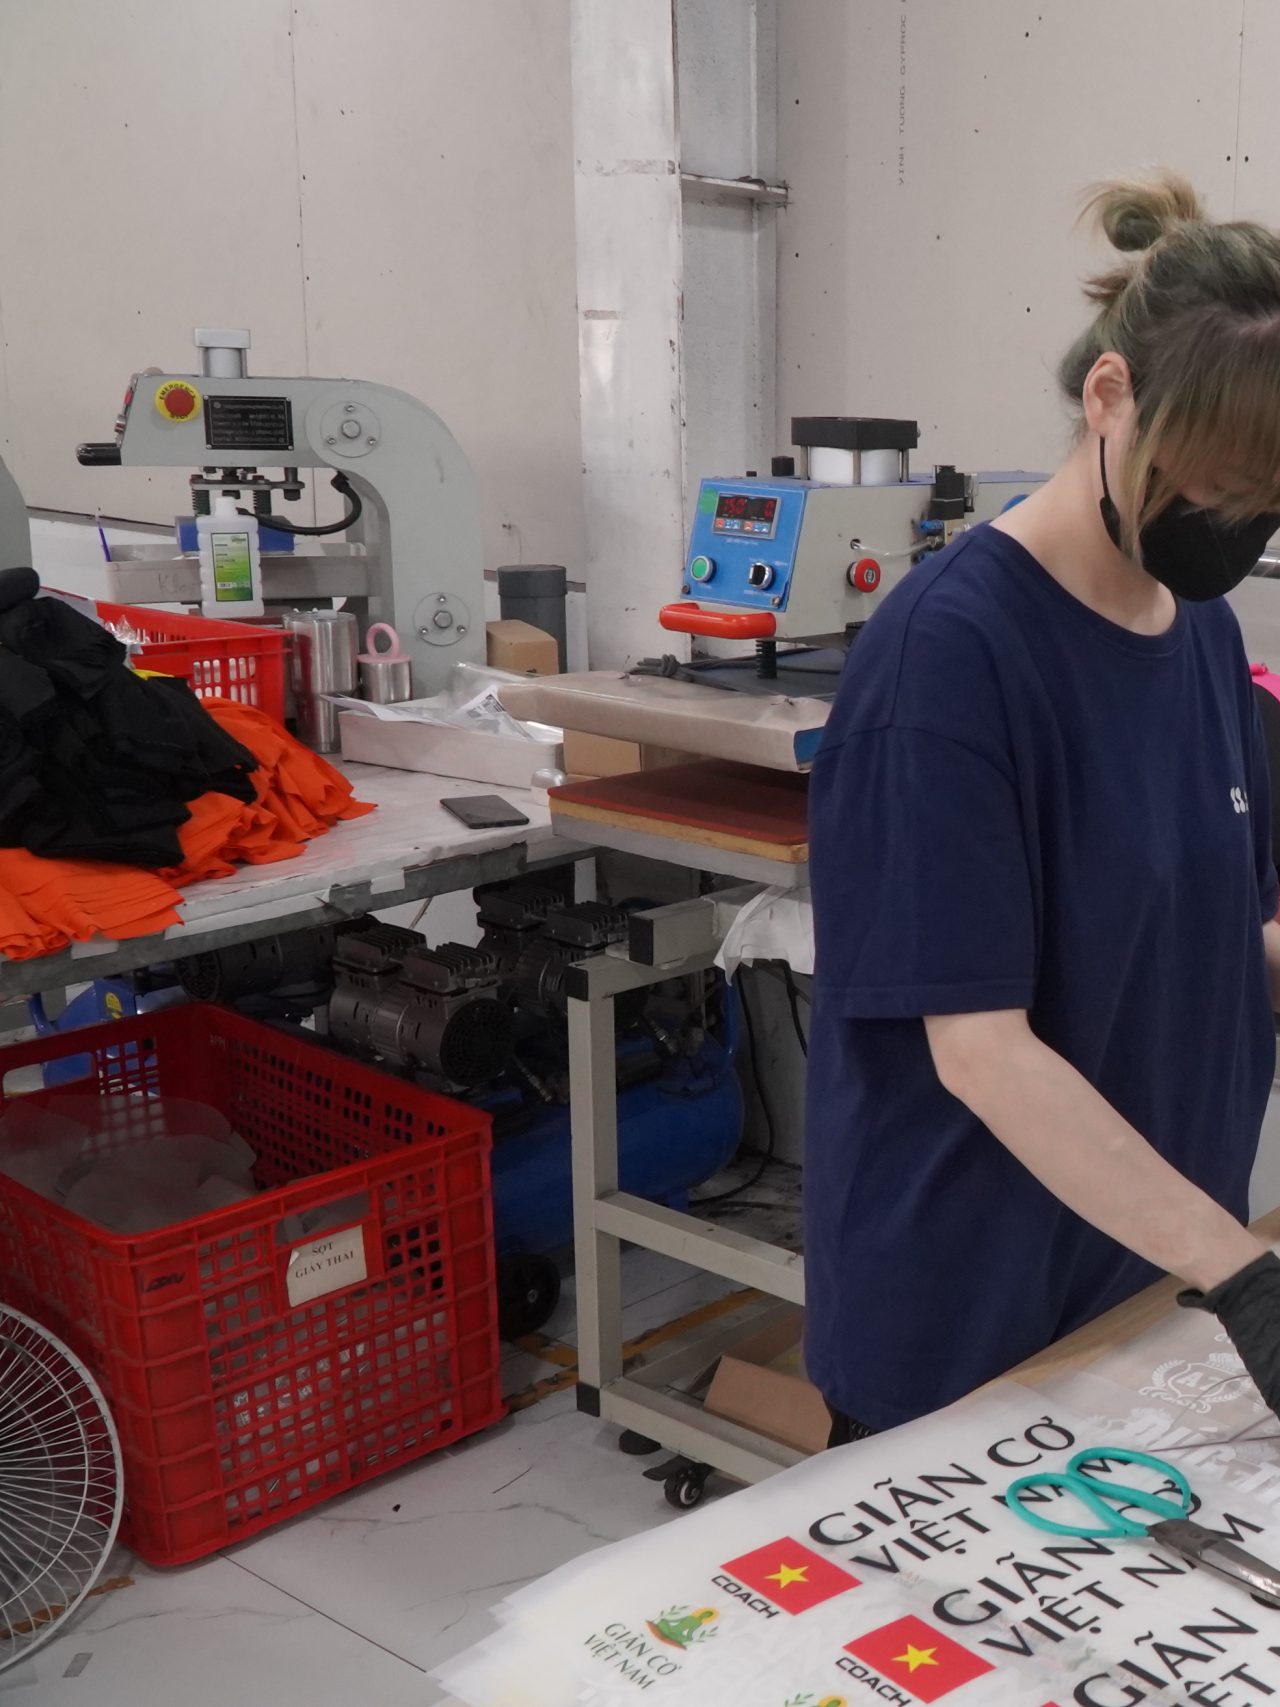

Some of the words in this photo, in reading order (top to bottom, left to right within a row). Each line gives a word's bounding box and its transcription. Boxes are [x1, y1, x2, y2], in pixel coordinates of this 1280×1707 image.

[809, 1462, 988, 1546] GIÃN
[987, 1415, 1076, 1468] CƠ
[849, 1506, 992, 1574] VIỆT
[711, 1574, 780, 1619] COACH
[933, 1537, 1116, 1627] GIÃN
[978, 1580, 1126, 1658] VIỆT
[614, 1658, 656, 1690] NAM
[835, 1656, 912, 1707] COACH
[1073, 1606, 1259, 1707] GIÃN
